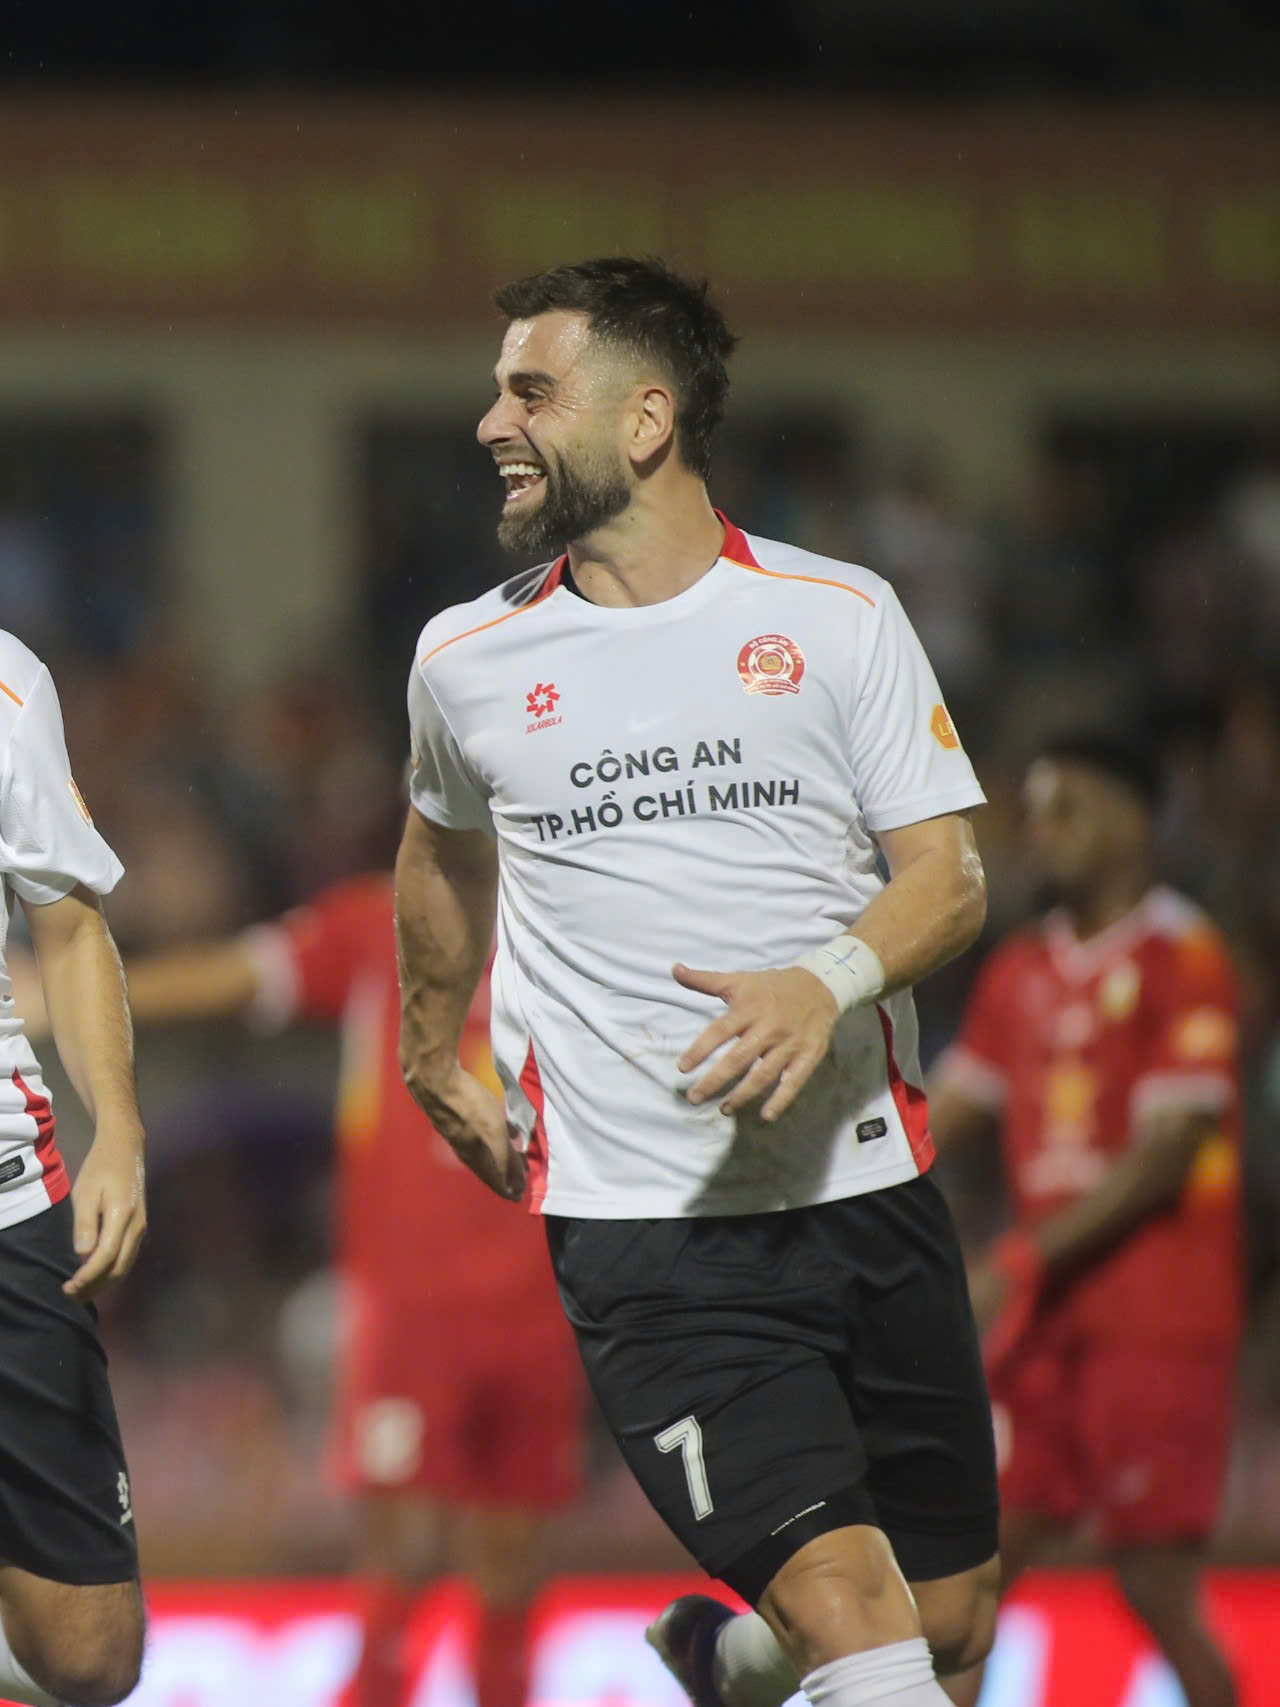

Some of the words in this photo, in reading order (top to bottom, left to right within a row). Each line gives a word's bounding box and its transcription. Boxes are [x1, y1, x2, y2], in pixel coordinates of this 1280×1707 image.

[569, 745, 679, 789] CÔNG
[691, 737, 742, 769] AN
[531, 789, 624, 842] TP.HỒ
[633, 782, 697, 822] CHÍ
[709, 779, 800, 812] MINH
[653, 1414, 714, 1521] 7
